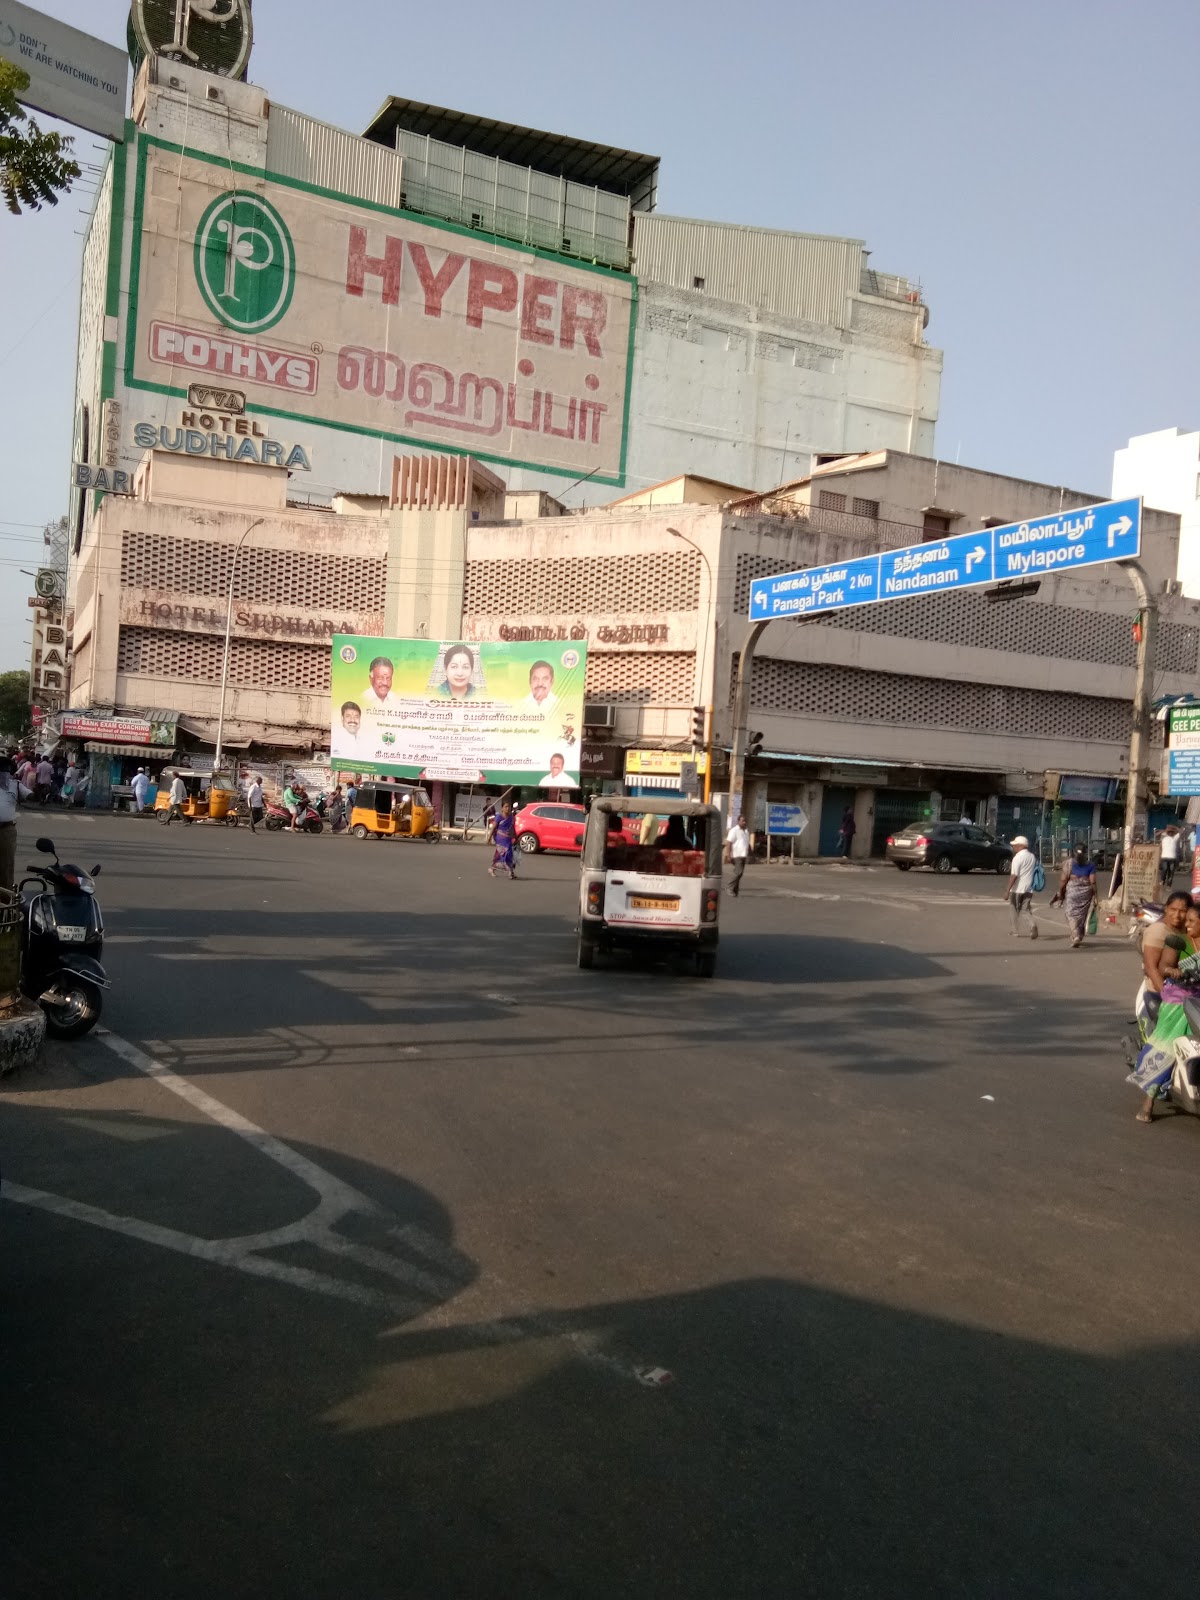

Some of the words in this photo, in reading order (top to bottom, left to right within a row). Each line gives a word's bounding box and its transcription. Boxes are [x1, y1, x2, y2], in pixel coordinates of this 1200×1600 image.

[20, 33, 47, 52] DON'T
[20, 44, 33, 58] WE
[35, 52, 52, 67] ARE
[55, 60, 98, 87] WATCHING
[101, 81, 118, 95] YOU
[345, 225, 608, 358] HYPER
[157, 327, 311, 389] POTHYS
[194, 386, 240, 409] VVA
[337, 345, 608, 444] ஹைப்பர்
[106, 401, 122, 467] EAGLE
[182, 411, 264, 436] HOTEL
[134, 422, 311, 469] SUDHARA
[76, 463, 128, 493] BAR
[999, 510, 1096, 547] மயிலாப்பூர்
[893, 542, 950, 575] நந்தனம்
[1008, 544, 1085, 572] Mylapore
[772, 573, 810, 593] பனகல்
[811, 568, 848, 591] பூங்கா
[849, 577, 856, 589] 2
[857, 573, 872, 587] Km
[885, 568, 958, 592] Nandanam
[773, 593, 815, 612] Panagal
[818, 588, 844, 605] Park
[140, 601, 221, 625] HOTEL
[235, 611, 354, 635] SUDHARA
[43, 626, 65, 688] BAR
[118, 723, 149, 731] COACHING
[1173, 721, 1188, 731] GEE
